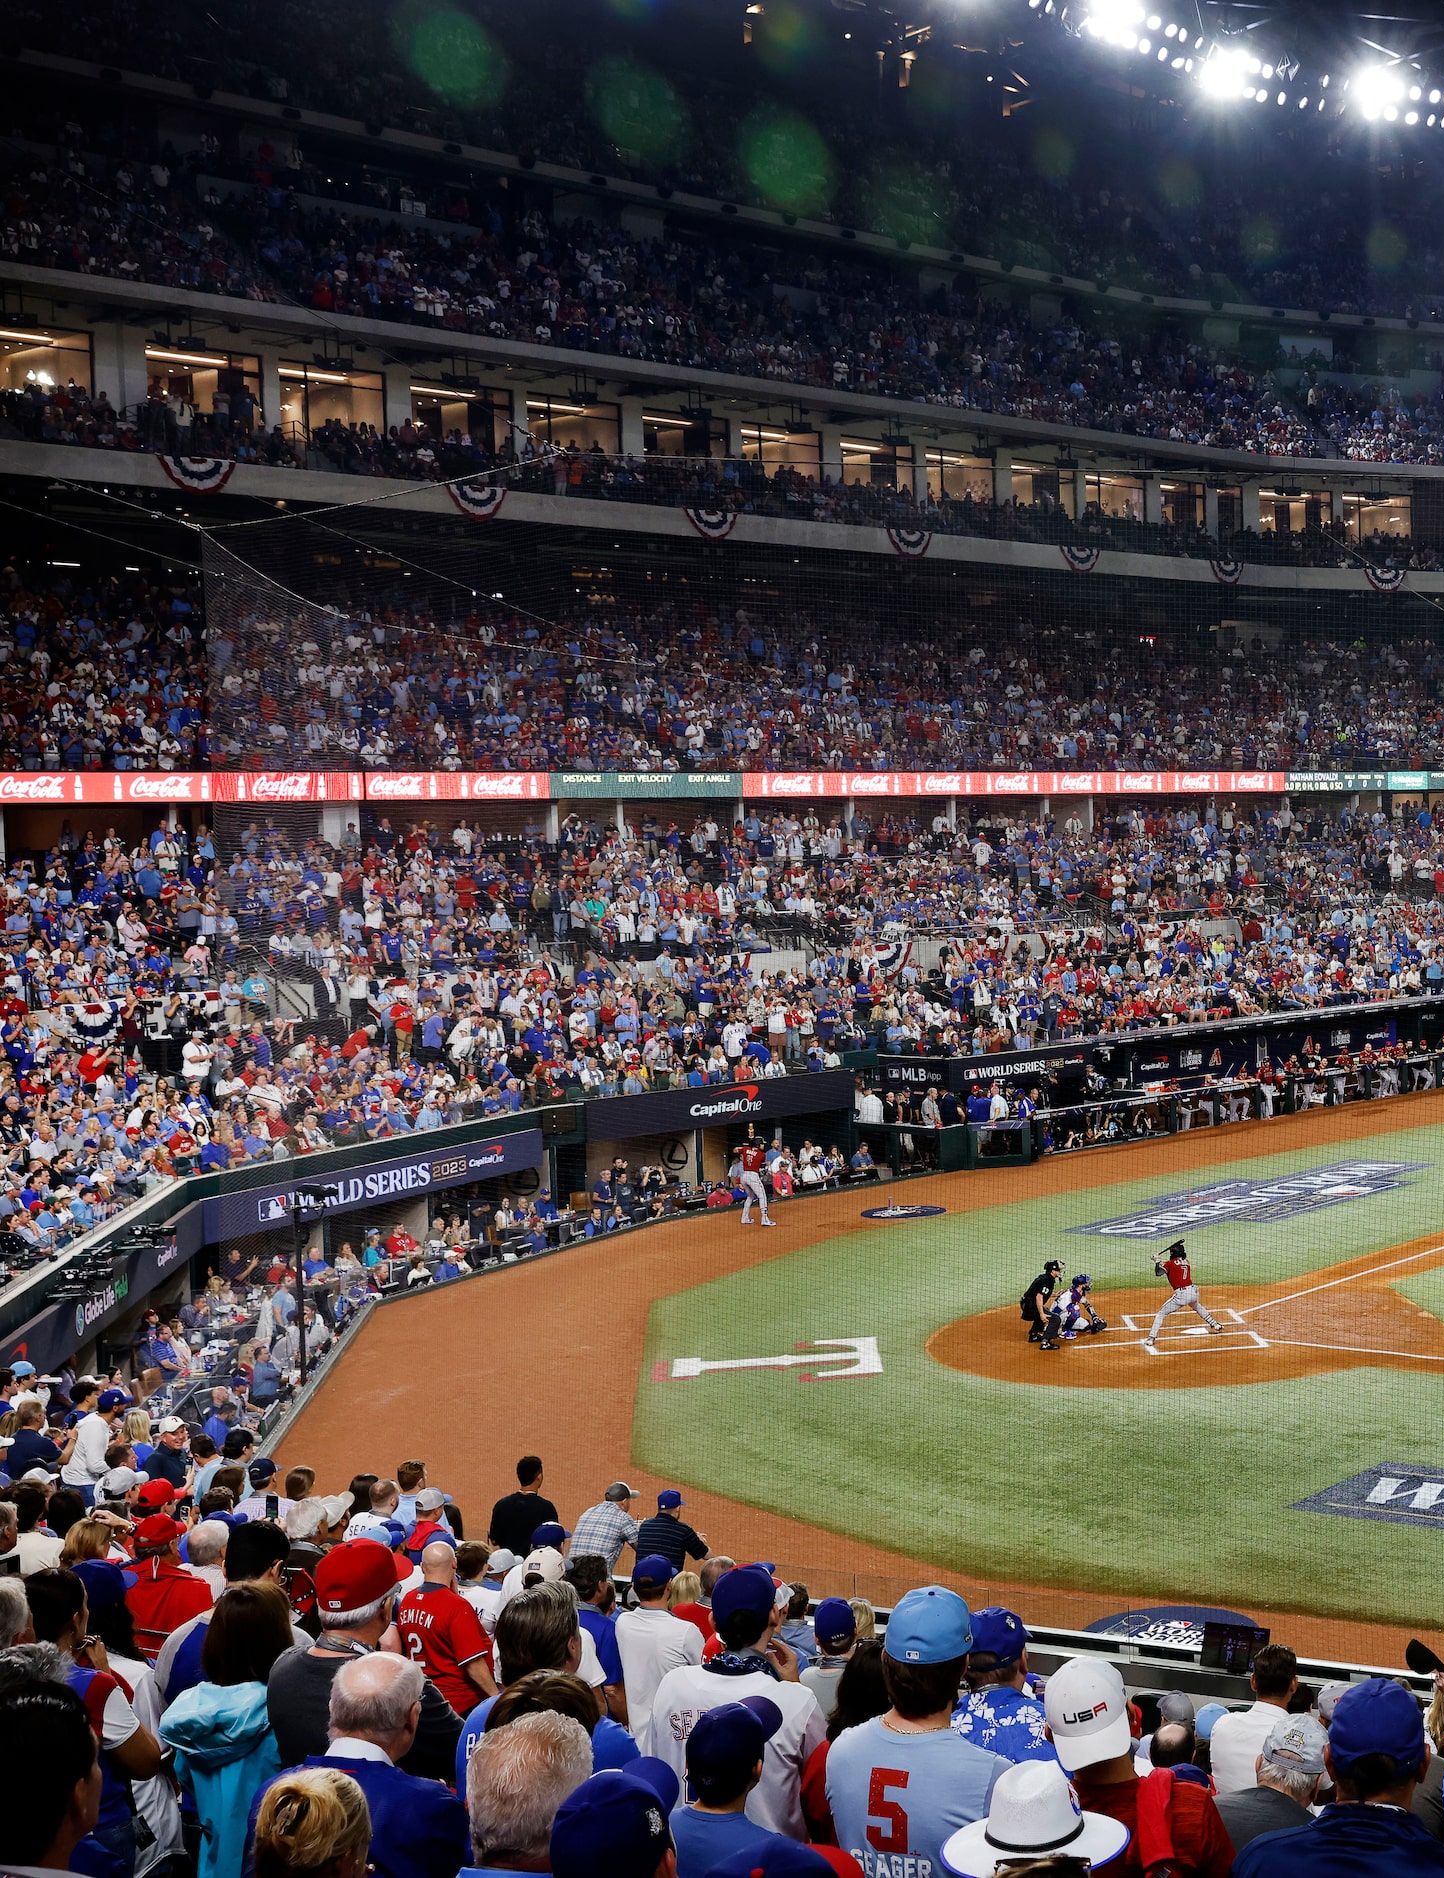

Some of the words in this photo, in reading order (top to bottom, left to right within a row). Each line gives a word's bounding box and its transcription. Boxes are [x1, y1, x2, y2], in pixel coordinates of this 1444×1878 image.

[0, 775, 65, 799] Coca-Cola
[129, 775, 194, 798] Coca-Cola
[251, 775, 310, 797] Coca-Cola
[368, 775, 424, 797] Coca-Cola
[473, 775, 526, 796] Coca-Cola
[562, 775, 602, 783] DISTANCE
[618, 775, 635, 783] EXIT
[636, 775, 673, 783] VELOCITY
[706, 774, 731, 782] ANGLE
[1289, 773, 1314, 781] NATHAN
[1314, 772, 1339, 781] EOVALDI
[902, 1067, 927, 1082] MLB
[926, 1071, 943, 1082] App
[979, 1063, 1013, 1079] WORLD
[1013, 1060, 1046, 1074] SERIES
[690, 1098, 763, 1117] CapitalOne
[365, 1163, 432, 1199] SERIES
[432, 1159, 467, 1179] 2023
[468, 1154, 505, 1169] CapitalOne
[1181, 1265, 1188, 1280] 7
[84, 1295, 104, 1325] Globe
[103, 1285, 115, 1311] Life
[114, 1273, 129, 1302] Field
[399, 1610, 434, 1629] SEMIEN
[1063, 1701, 1108, 1725] USA
[866, 1767, 910, 1855] 5
[850, 1848, 933, 1878] SEAGER
